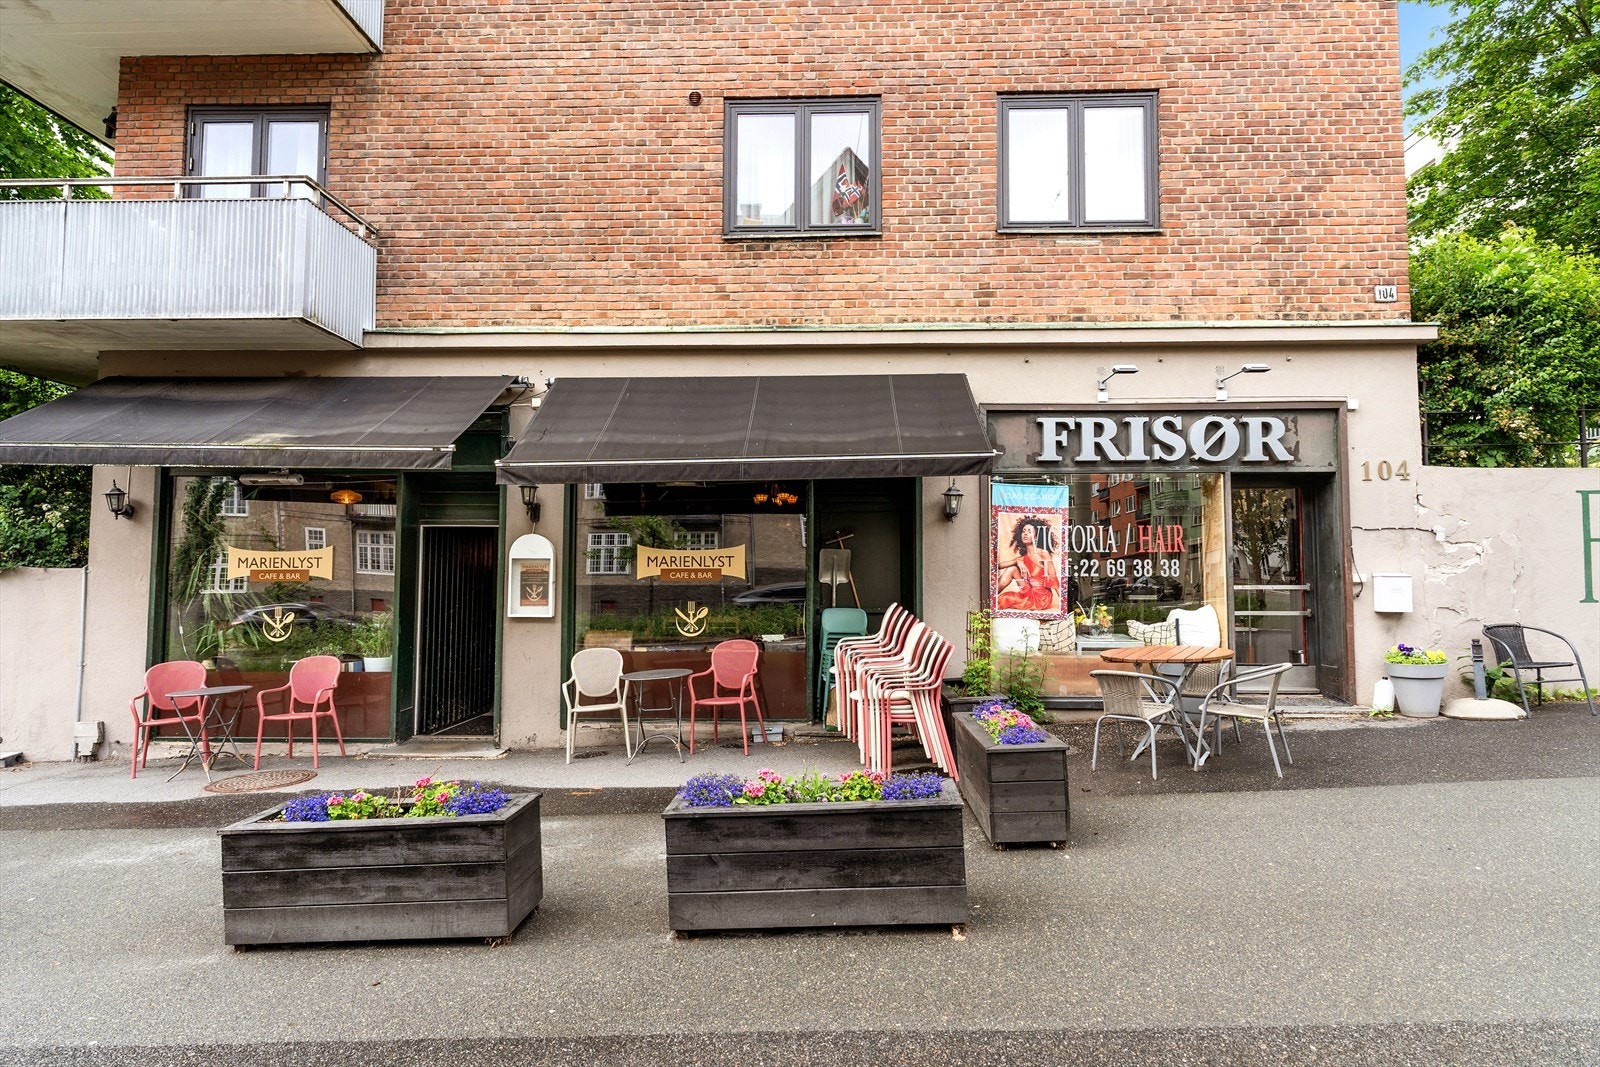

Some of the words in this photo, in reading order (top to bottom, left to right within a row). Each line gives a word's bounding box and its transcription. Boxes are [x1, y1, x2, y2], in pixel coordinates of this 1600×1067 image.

[1378, 288, 1395, 300] 104
[1036, 415, 1295, 462] FRISØR
[1361, 460, 1410, 481] 104
[1030, 525, 1117, 553] VICTORIA
[1137, 525, 1186, 553] HAIR
[237, 557, 323, 569] MARIENLYST
[646, 555, 735, 568] MARIENLYST
[1106, 558, 1126, 577] 69
[1133, 558, 1153, 577] 38
[1160, 558, 1180, 577] 38
